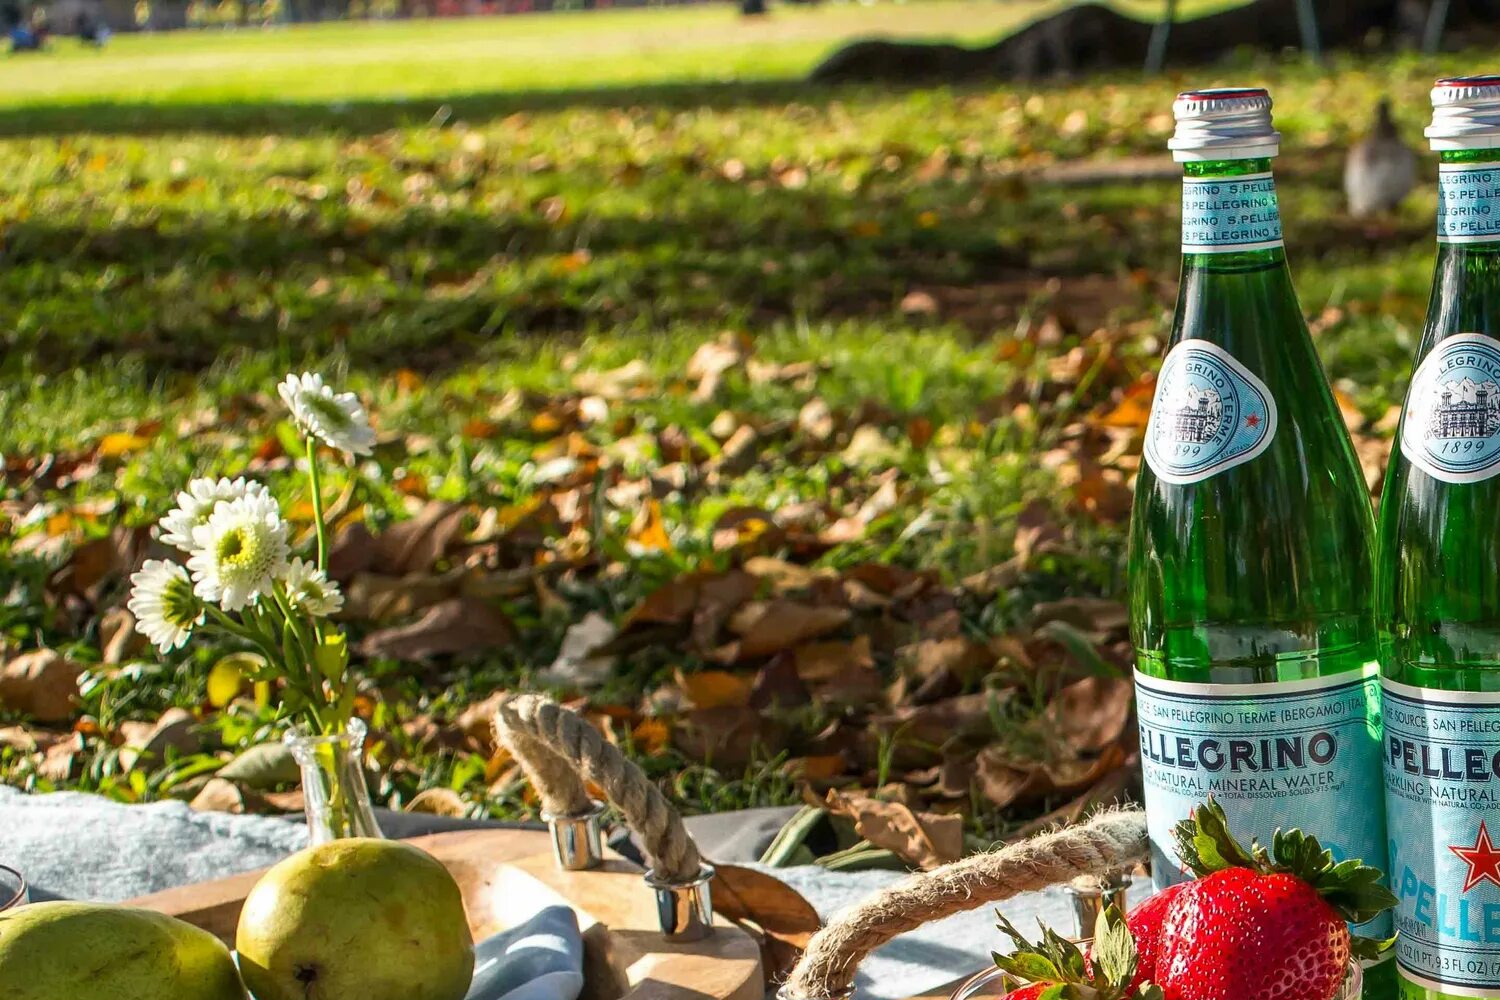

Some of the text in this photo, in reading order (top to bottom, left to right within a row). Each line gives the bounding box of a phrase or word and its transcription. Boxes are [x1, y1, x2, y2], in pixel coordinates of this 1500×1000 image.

[1212, 391, 1234, 446] TERME
[1441, 440, 1485, 454] 1899
[1171, 708, 1234, 725] PELLEGRINO
[1238, 711, 1276, 724] TERME
[1281, 701, 1345, 723] (BERGAMO)
[1433, 718, 1456, 732] SAN
[1154, 770, 1203, 790] NATURAL
[1209, 778, 1278, 792] MINERAL
[1283, 770, 1335, 789] WATER
[1224, 791, 1245, 799] TOTAL
[1247, 790, 1287, 799] DISSOLVED
[1429, 785, 1498, 802] NATURAL
[1452, 958, 1465, 973] FL
[1467, 960, 1488, 976] OZ)
